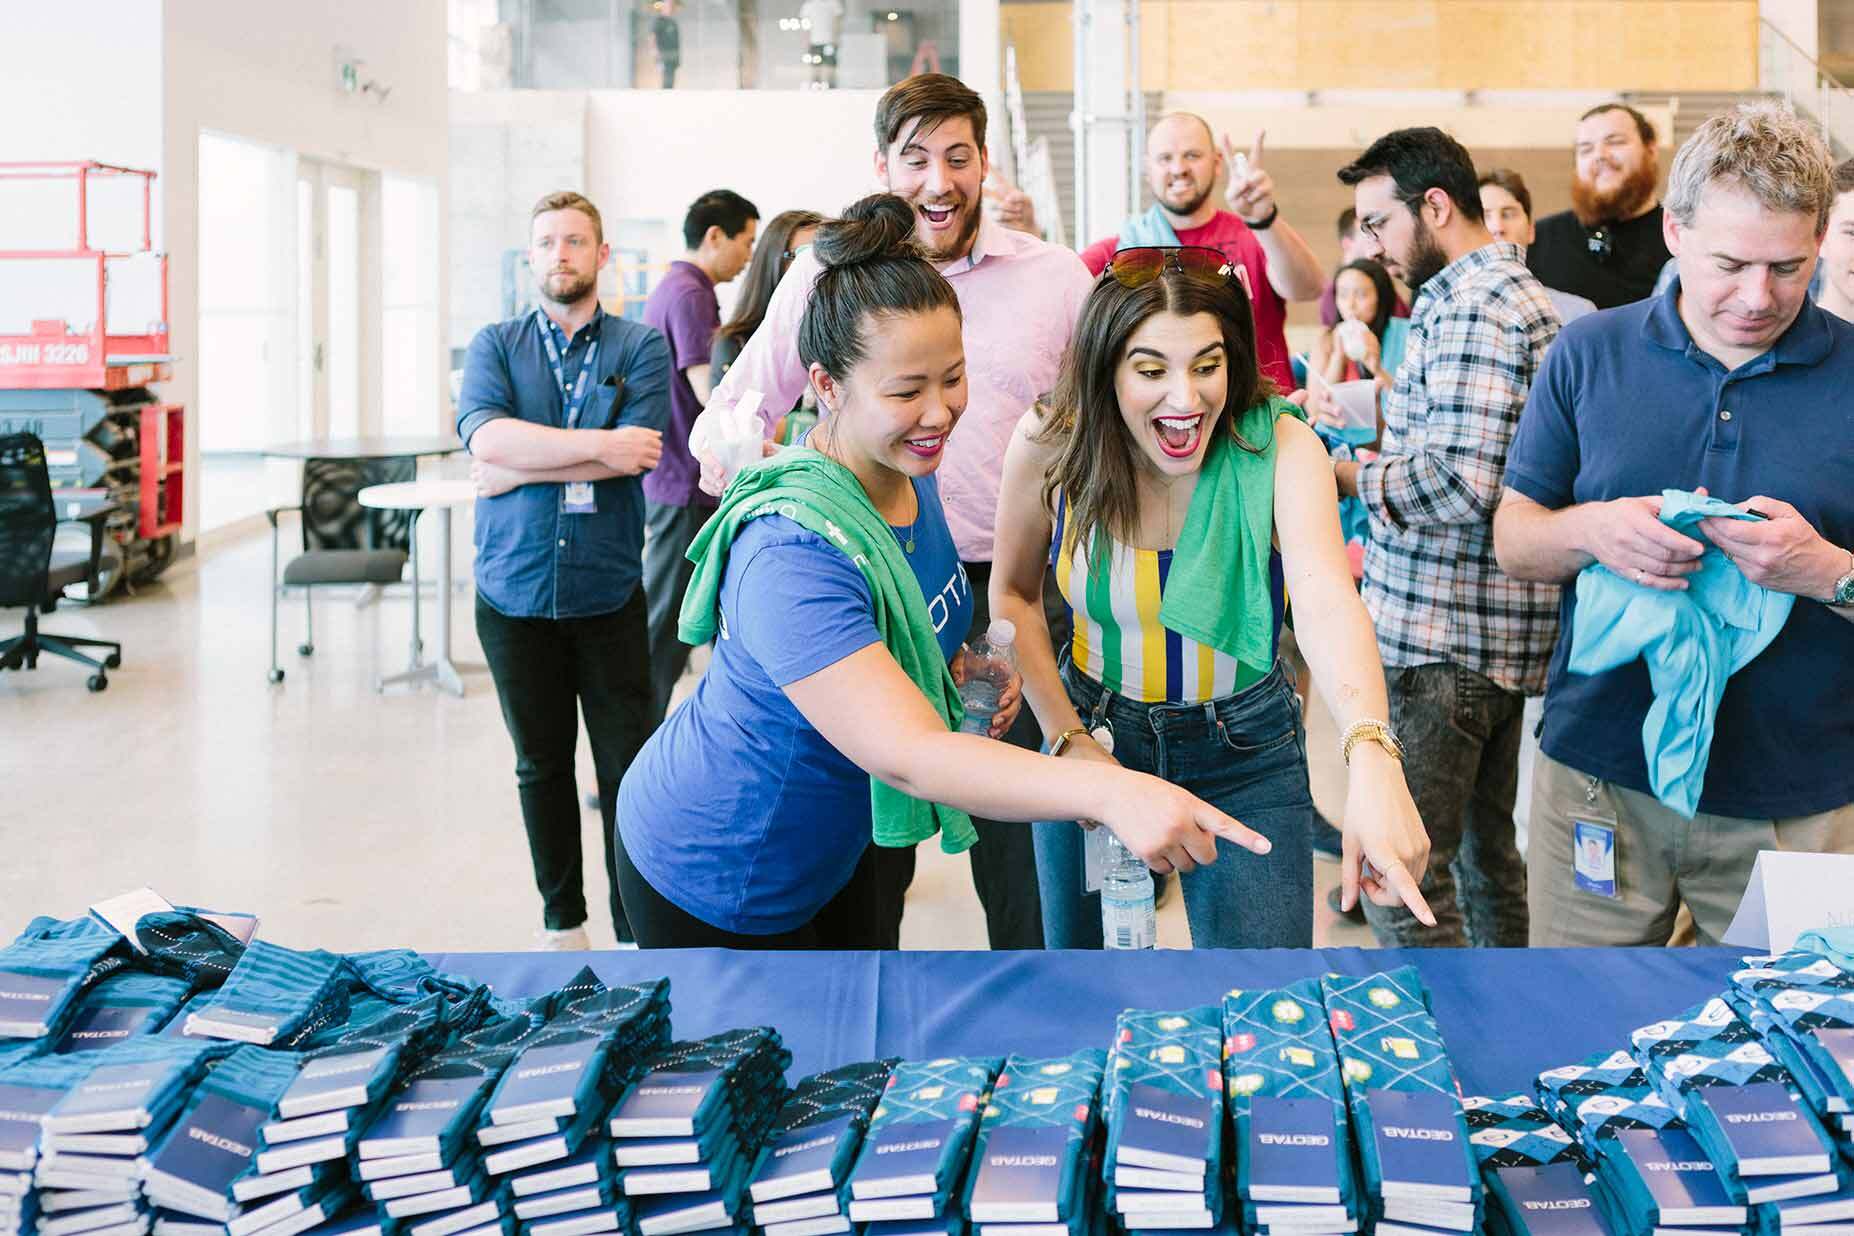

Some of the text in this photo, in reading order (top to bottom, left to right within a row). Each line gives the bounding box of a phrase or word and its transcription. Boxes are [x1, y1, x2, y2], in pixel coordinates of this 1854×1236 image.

[1136, 1108, 1204, 1129] GEOTAB
[1726, 1111, 1798, 1123] GEOTAB
[1258, 1133, 1329, 1146] GEOTAB
[1382, 1126, 1454, 1141] GEOTAB
[188, 1126, 252, 1158] GEOTAB
[990, 1154, 1057, 1167] GEOTAB
[1645, 1161, 1714, 1172] GEOTAB
[1523, 1199, 1591, 1210] GEOTAB
